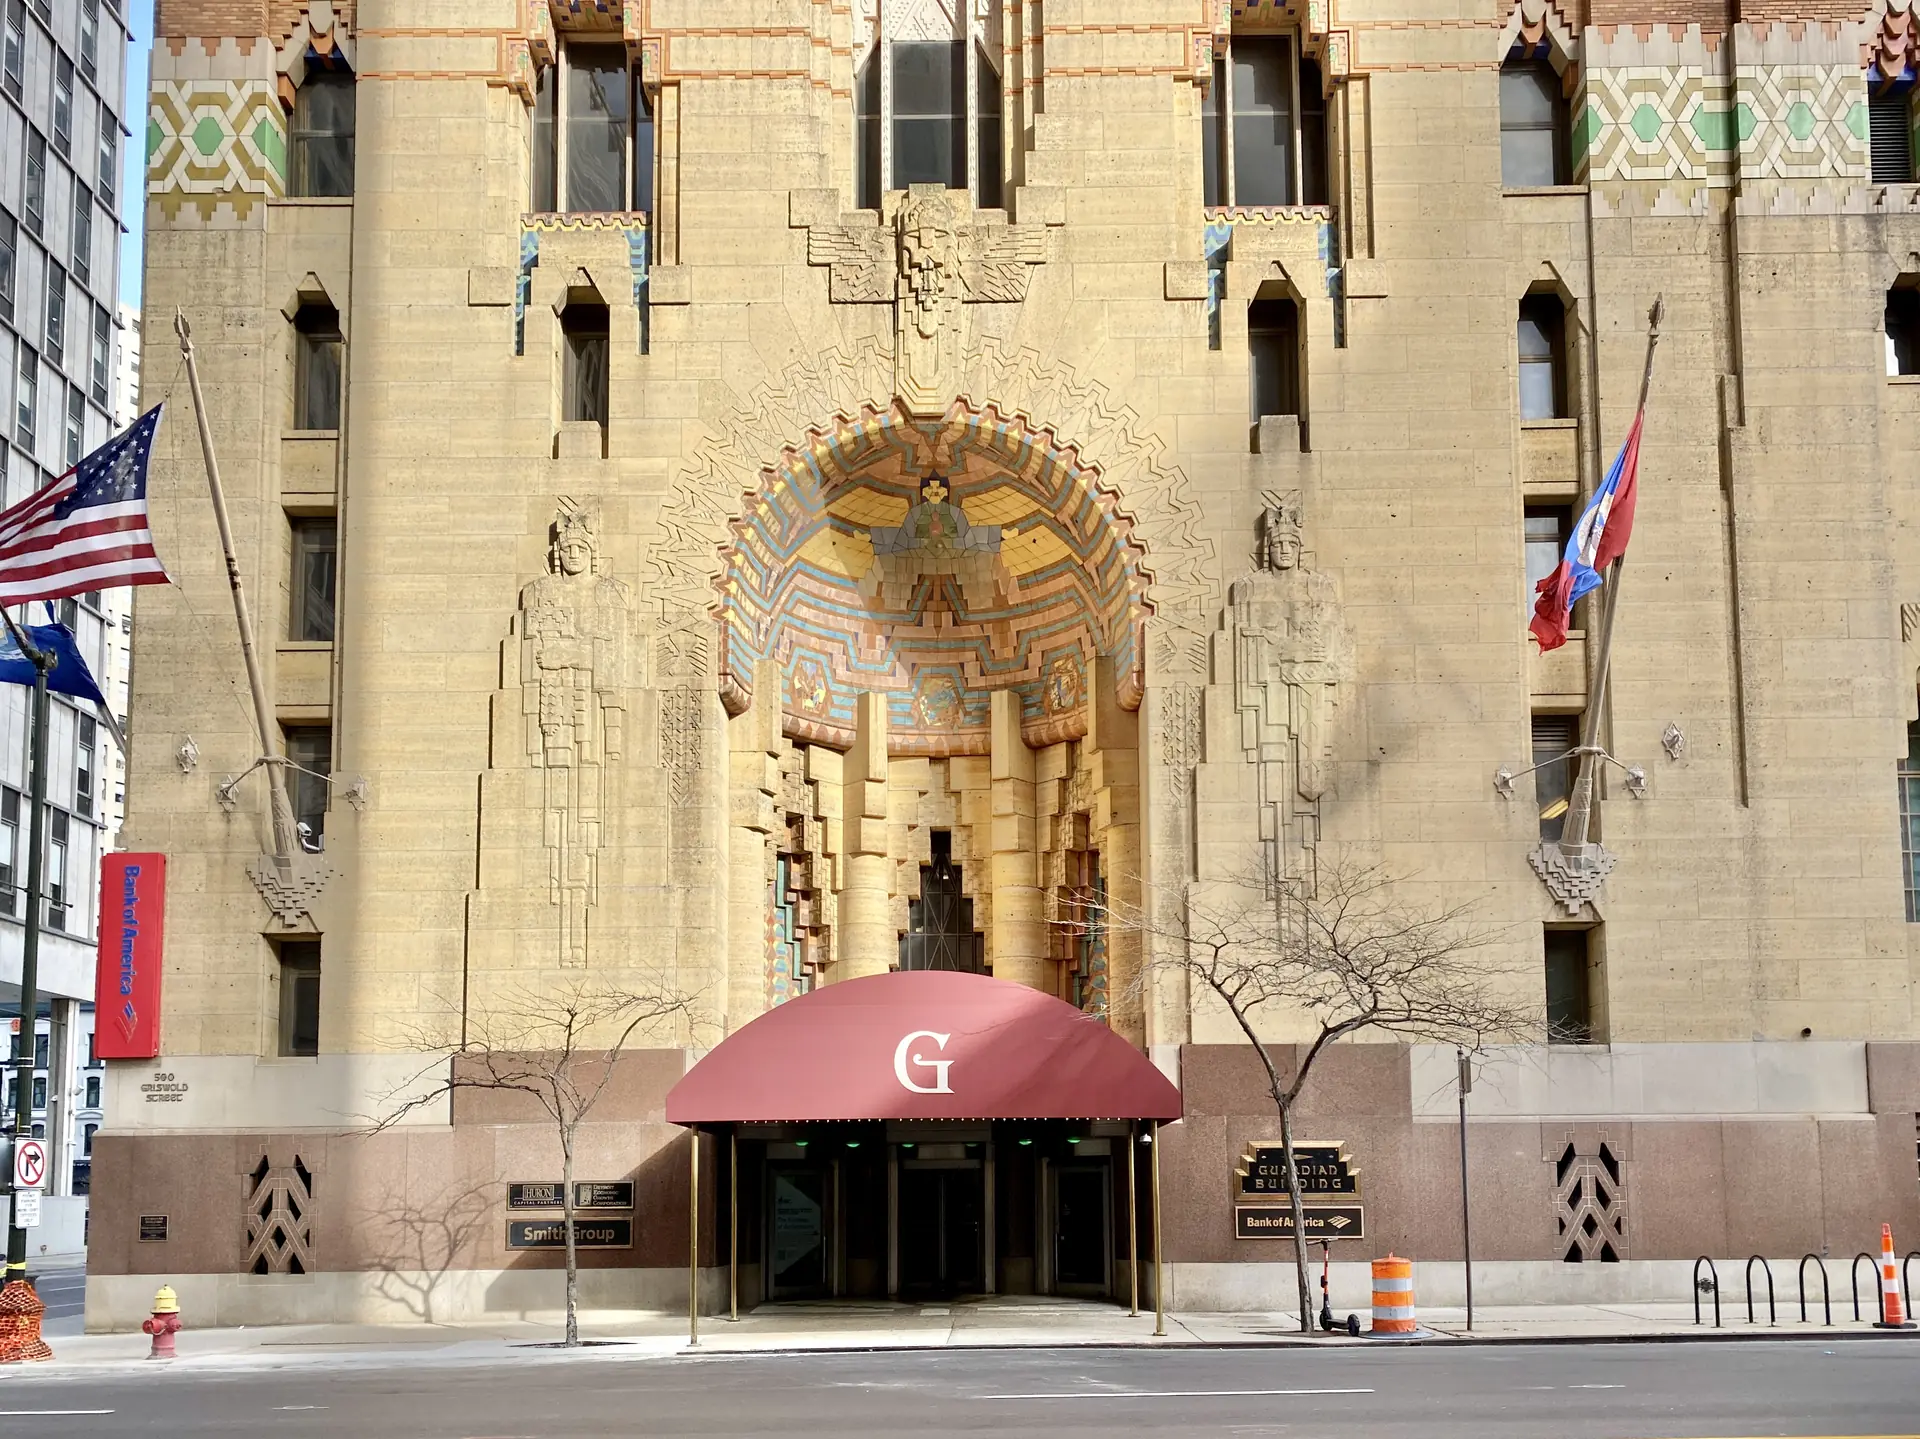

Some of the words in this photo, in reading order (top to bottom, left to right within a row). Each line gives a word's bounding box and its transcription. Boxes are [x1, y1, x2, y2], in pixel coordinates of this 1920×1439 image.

[124, 865, 141, 906] Bank
[123, 908, 139, 925] of
[120, 926, 138, 996] America
[894, 1030, 955, 1094] G
[154, 1073, 175, 1082] 500
[140, 1083, 189, 1092] GRISWOLD
[145, 1093, 183, 1103] STREET
[1255, 1178, 1342, 1189] BUIDING
[526, 1187, 551, 1198] HURON
[1247, 1217, 1273, 1227] Bank
[1273, 1217, 1283, 1227] of
[1283, 1217, 1324, 1227] Arica
